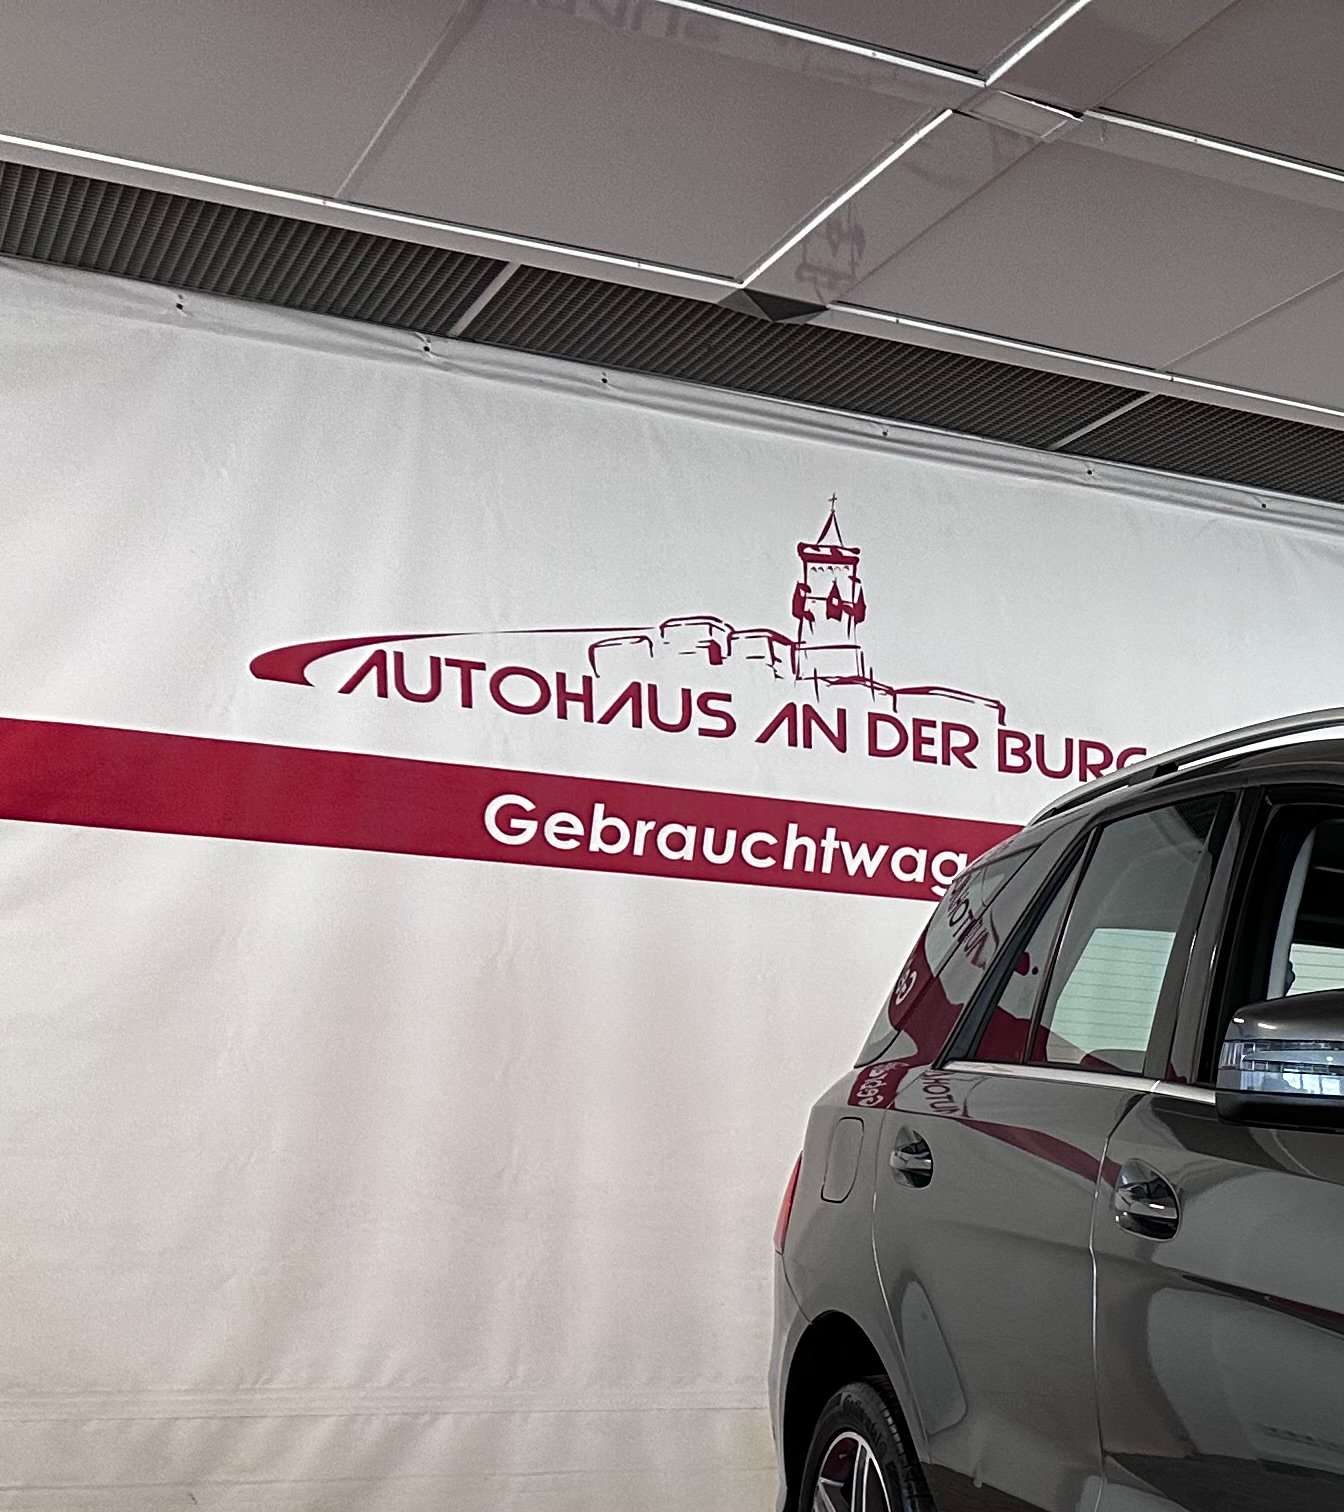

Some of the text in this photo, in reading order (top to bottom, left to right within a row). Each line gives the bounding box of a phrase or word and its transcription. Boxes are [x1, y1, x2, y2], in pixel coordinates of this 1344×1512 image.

[338, 649, 738, 739] AUTOHAUS
[755, 701, 848, 754] AN
[867, 711, 978, 770] DER
